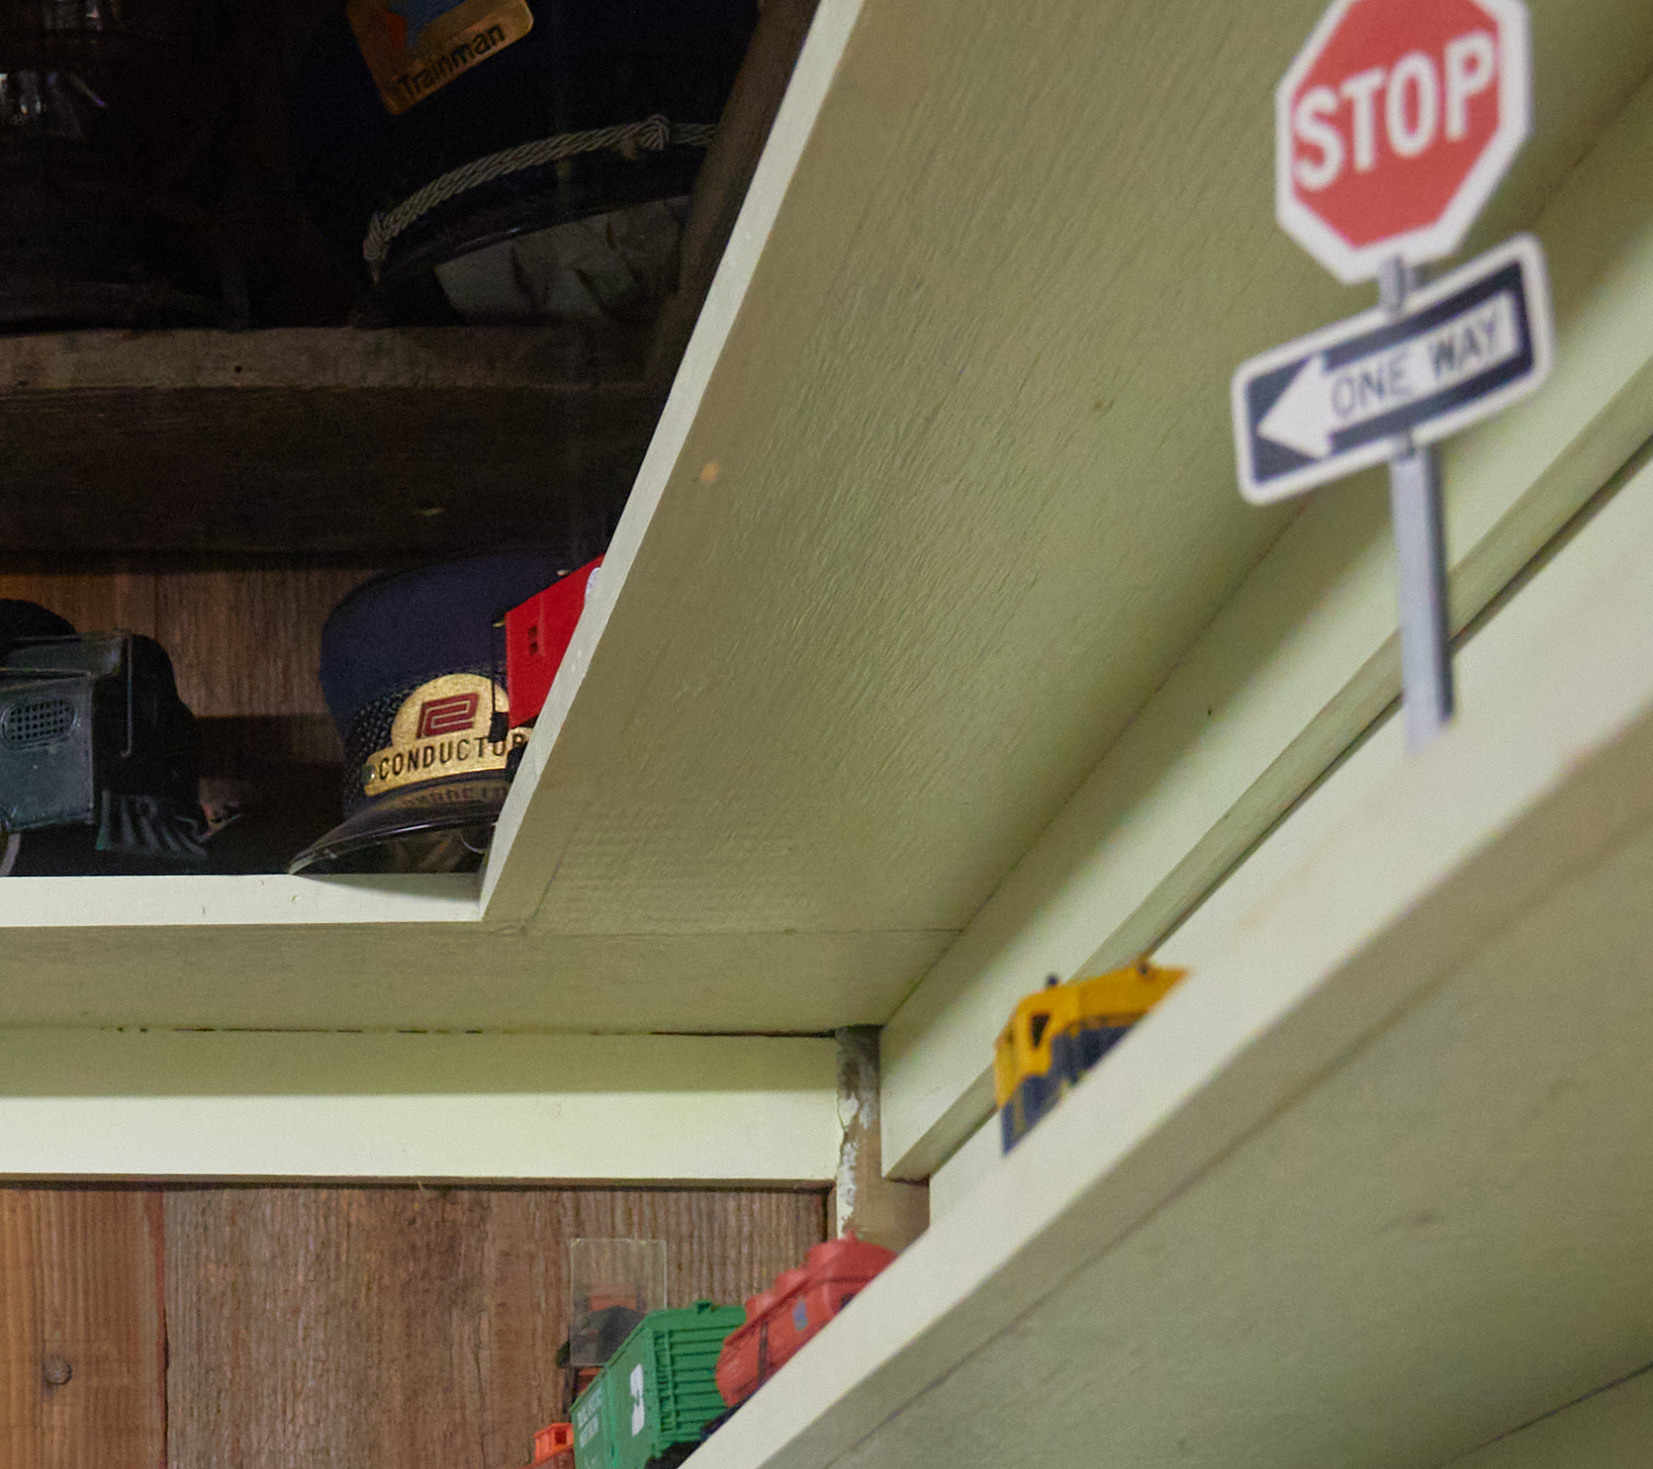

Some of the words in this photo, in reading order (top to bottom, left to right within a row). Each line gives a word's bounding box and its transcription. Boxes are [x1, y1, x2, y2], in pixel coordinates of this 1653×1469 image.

[397, 24, 506, 97] Trainman
[1295, 30, 1496, 191] STOP
[1333, 350, 1414, 418] ONE
[1427, 307, 1498, 376] WAY
